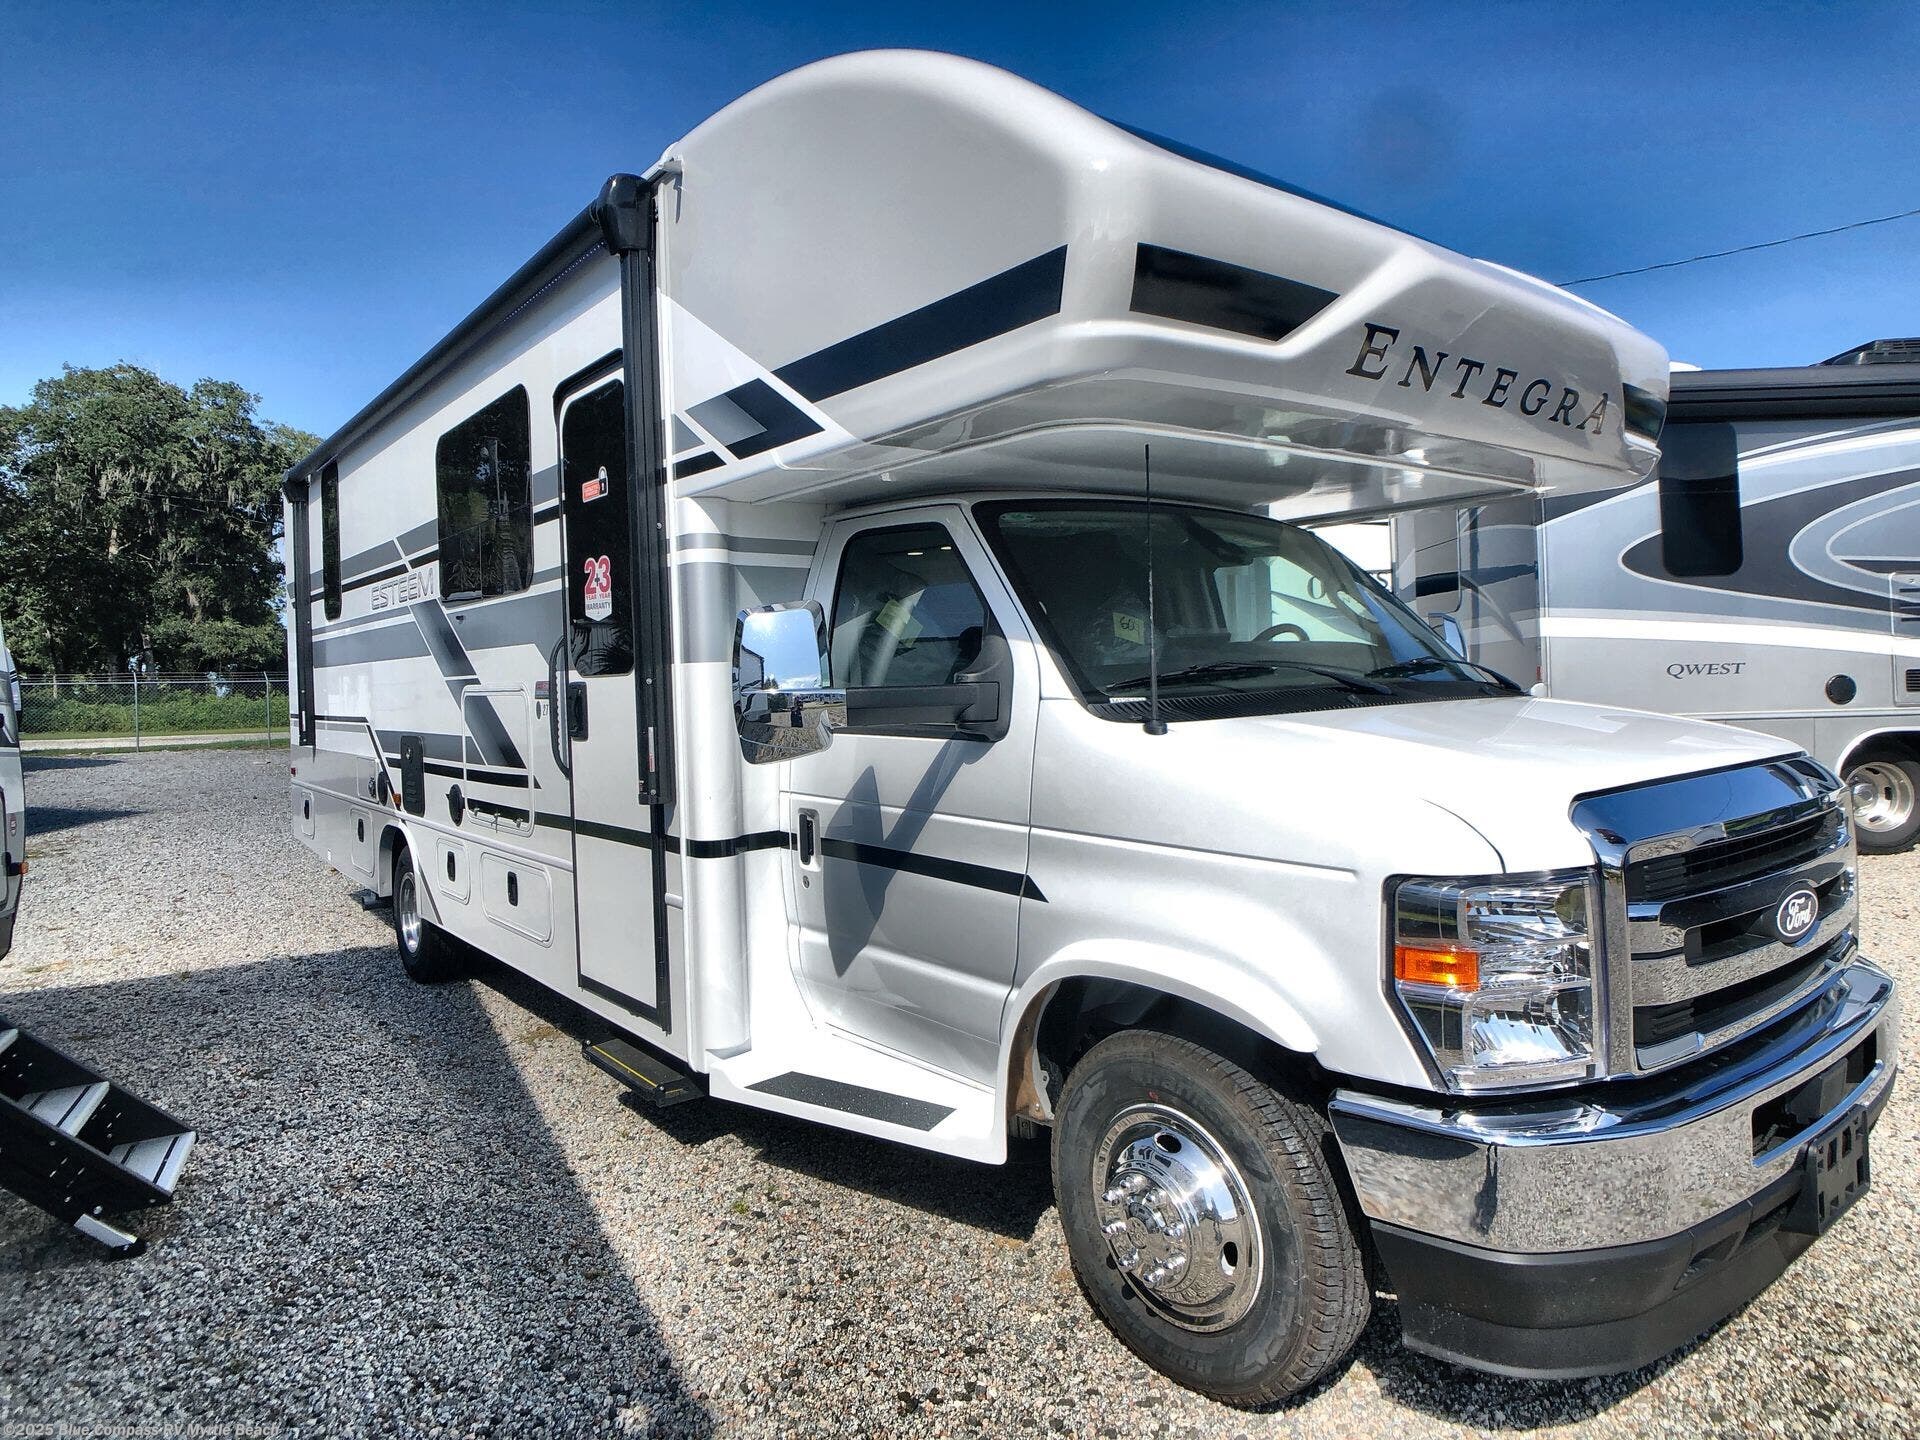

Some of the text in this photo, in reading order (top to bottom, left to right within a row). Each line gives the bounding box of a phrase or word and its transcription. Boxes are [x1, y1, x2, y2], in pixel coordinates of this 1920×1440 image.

[1345, 322, 1609, 435] ENTEGRA
[372, 567, 434, 610] ESTEEM
[586, 601, 611, 611] WARRANTY
[1666, 662, 1746, 680] QWEST
[1786, 896, 1812, 931] Ford
